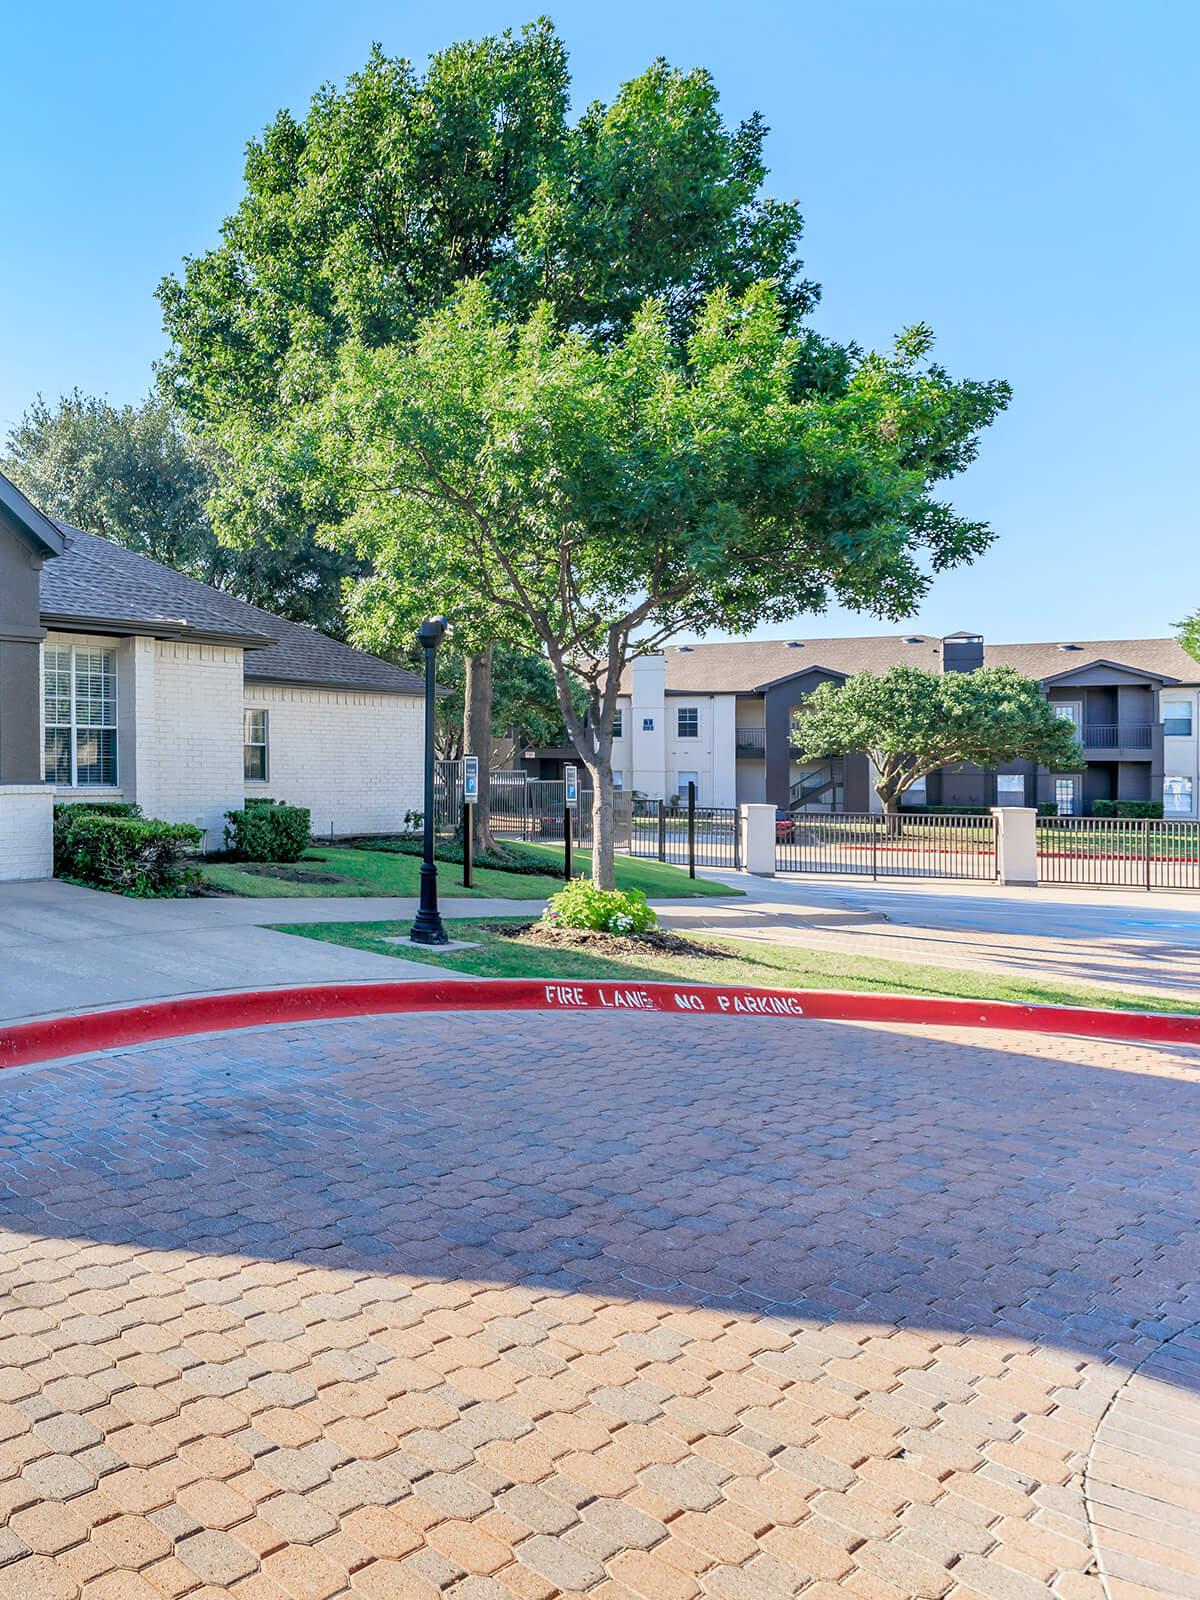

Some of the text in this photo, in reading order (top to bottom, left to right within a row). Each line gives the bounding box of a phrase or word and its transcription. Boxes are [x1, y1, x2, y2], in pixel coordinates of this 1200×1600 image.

[545, 985, 803, 1015] FIRE LANE NO PARKING
